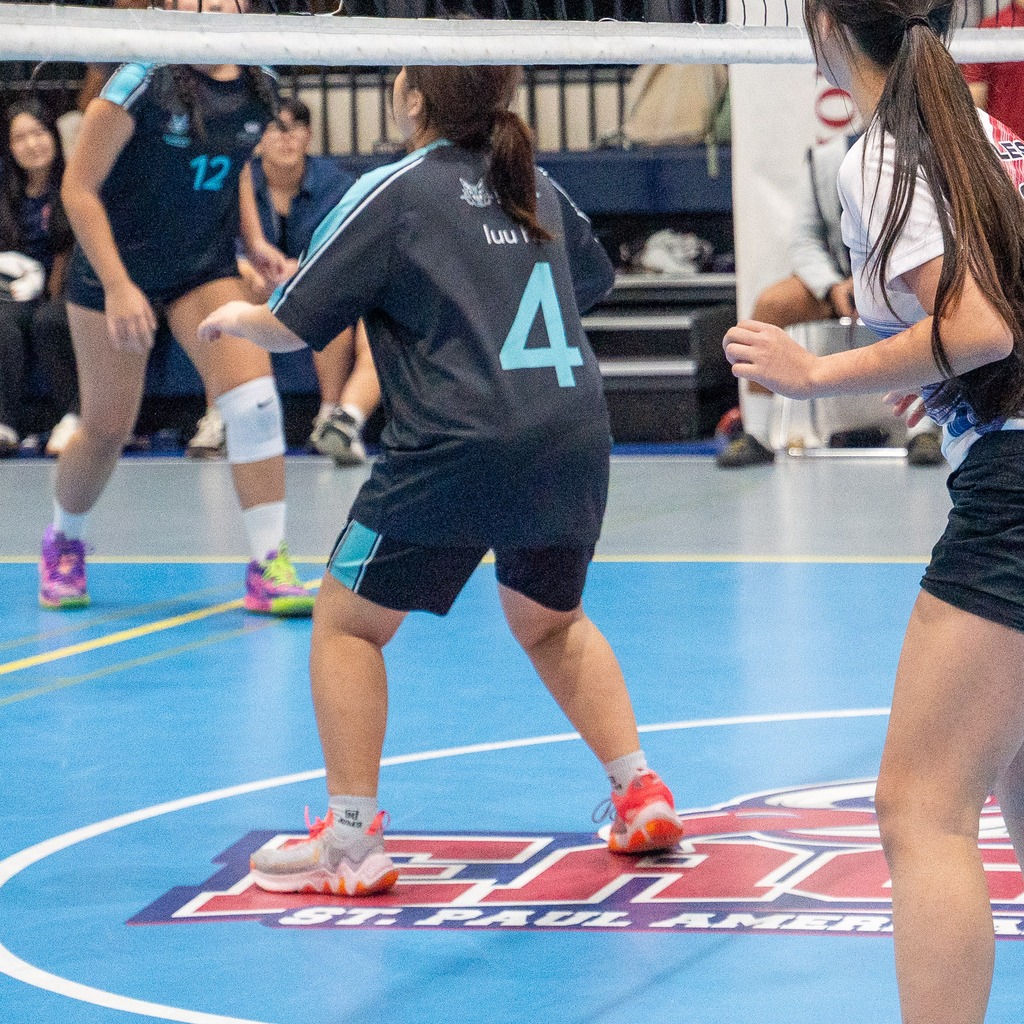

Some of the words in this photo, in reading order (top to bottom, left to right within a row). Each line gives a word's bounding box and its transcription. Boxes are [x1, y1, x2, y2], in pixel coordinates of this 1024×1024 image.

[190, 154, 232, 191] 12
[499, 261, 583, 388] 4
[278, 906, 403, 926] ST.
[413, 908, 632, 927] PAUL
